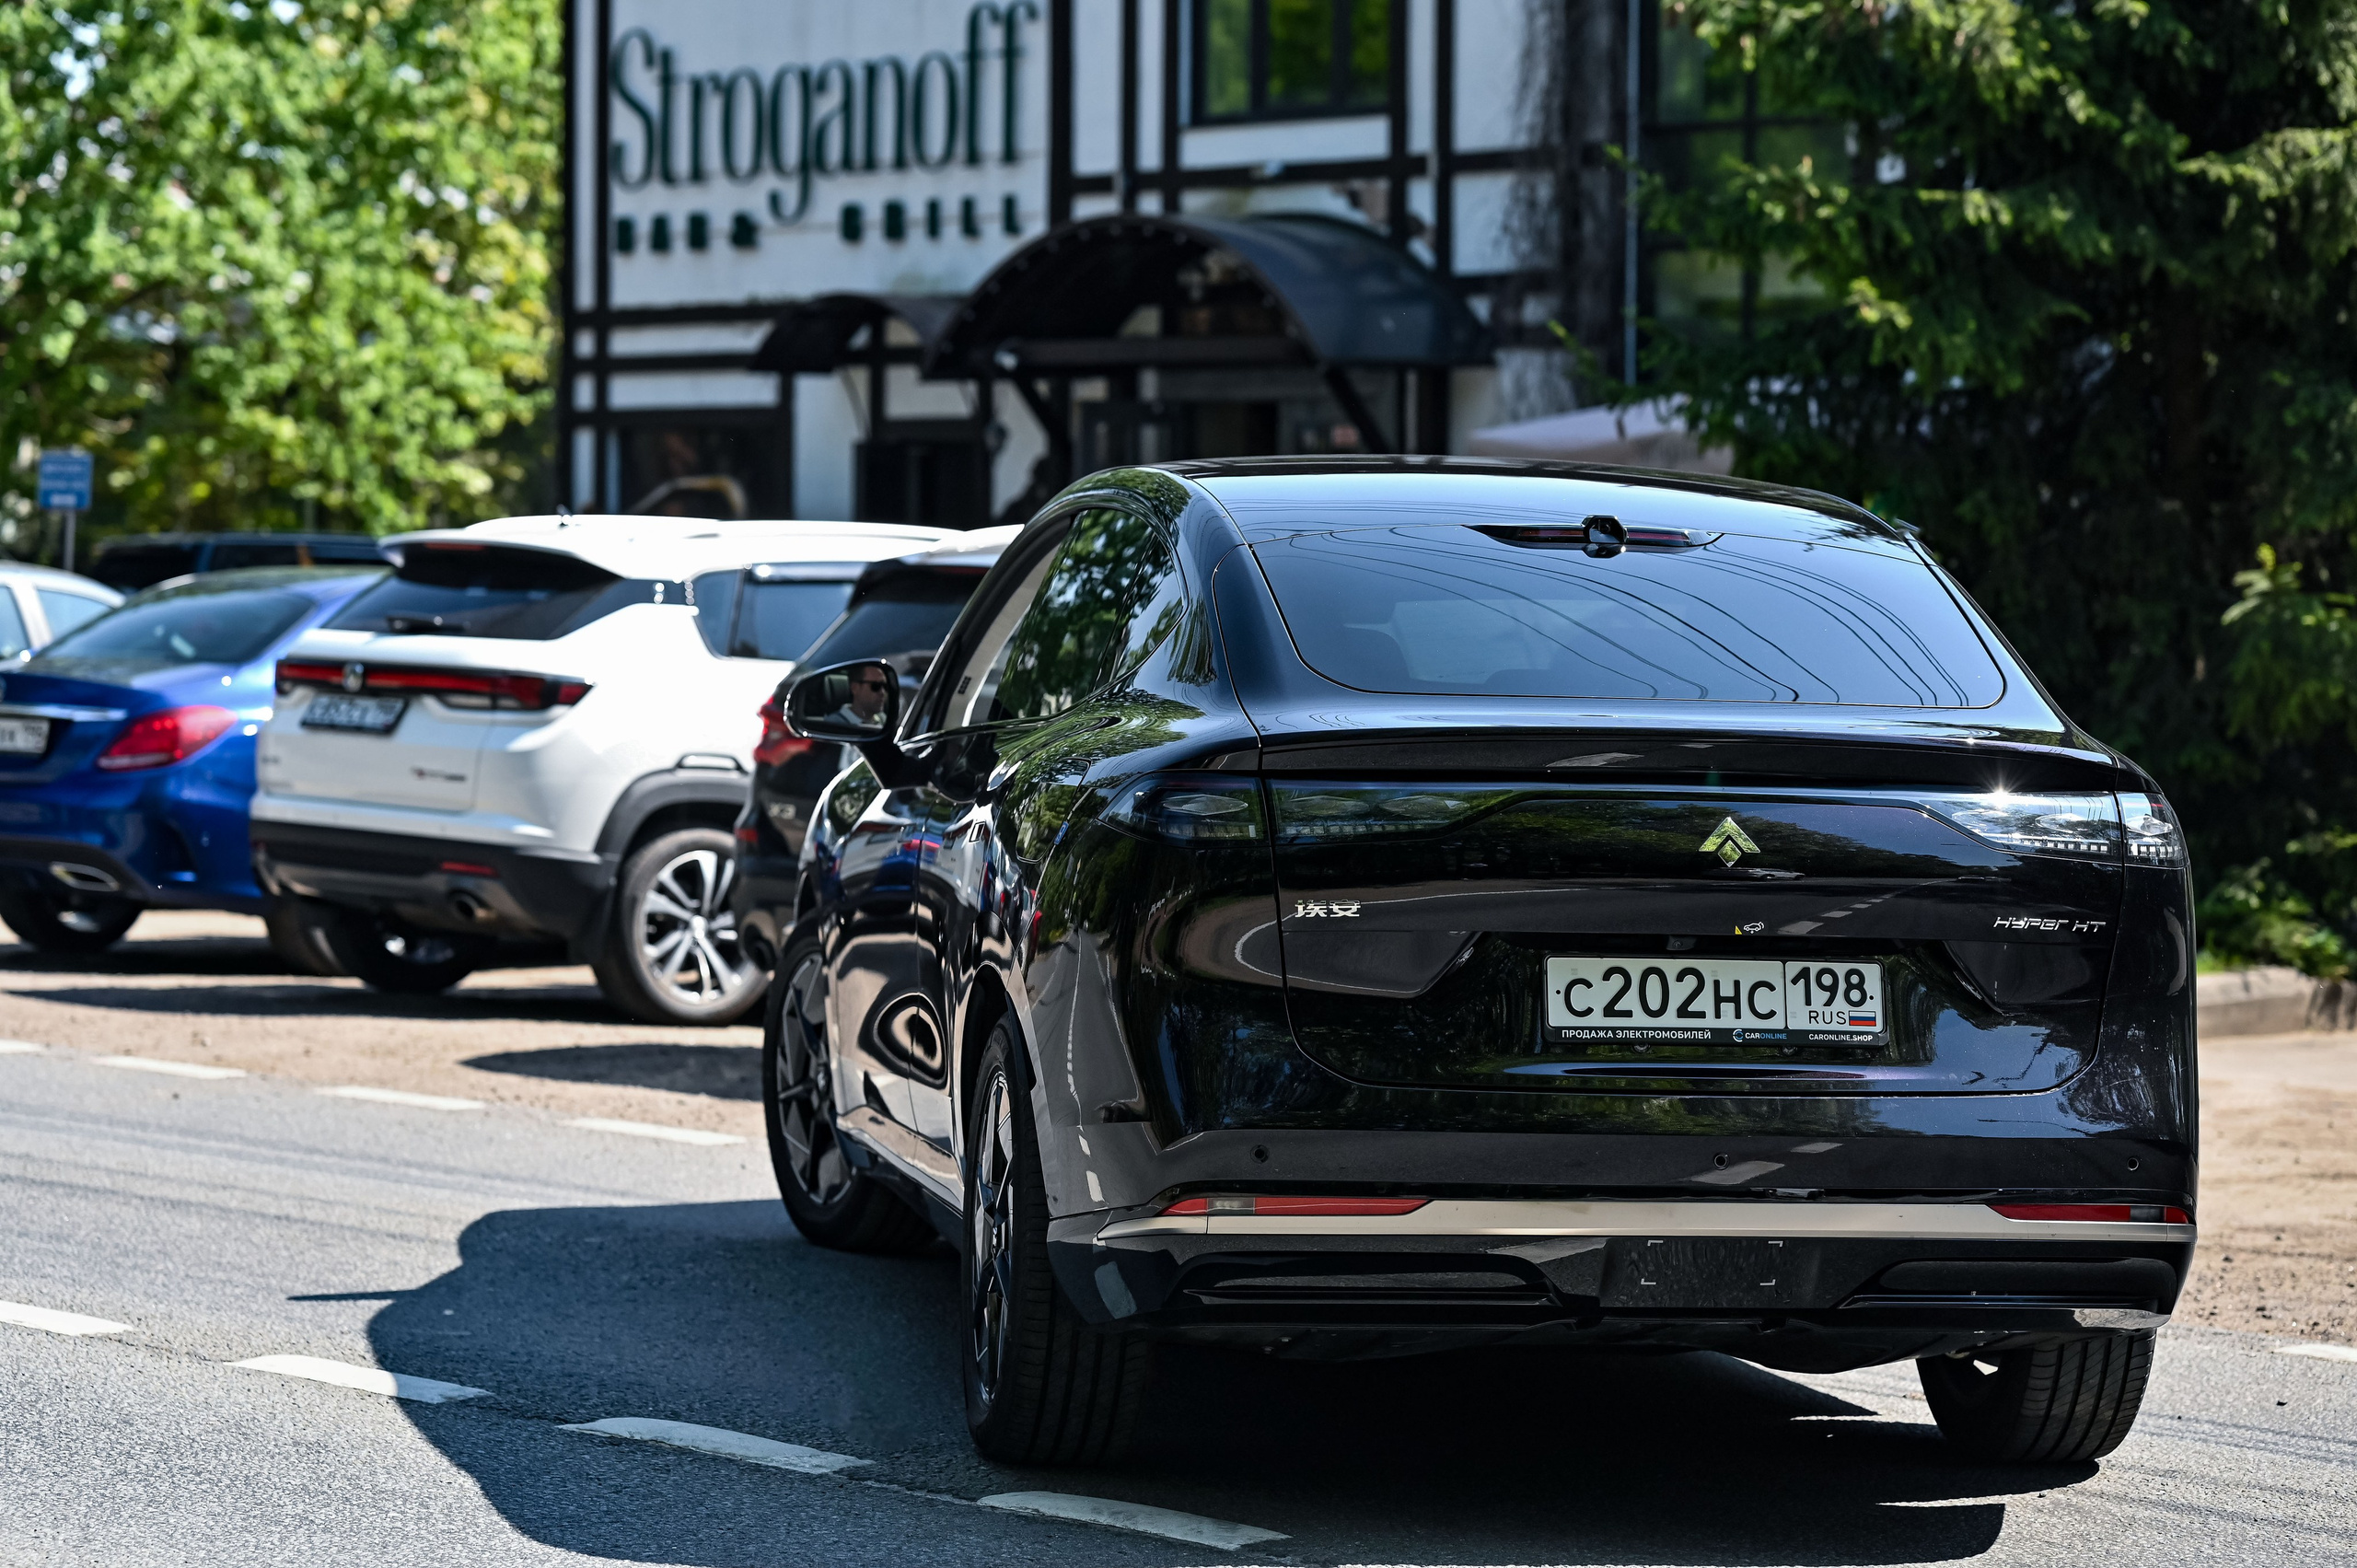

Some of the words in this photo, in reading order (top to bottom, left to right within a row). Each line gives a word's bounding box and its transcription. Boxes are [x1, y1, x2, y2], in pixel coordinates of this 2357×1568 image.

[610, 0, 1039, 226] Stroganoff
[1295, 899, 1362, 918] 埃安
[2072, 920, 2107, 933] HT
[1790, 966, 1868, 1008] 198
[1808, 1010, 1847, 1025] RUS
[1562, 1029, 1614, 1040] ПРОДАЖА
[1615, 1028, 1712, 1040] ЭЛЕКТРОМОБИЛЕЙ
[1745, 1031, 1787, 1040] CARONLINE
[1808, 1032, 1874, 1042] CARONLINE.SHOP
